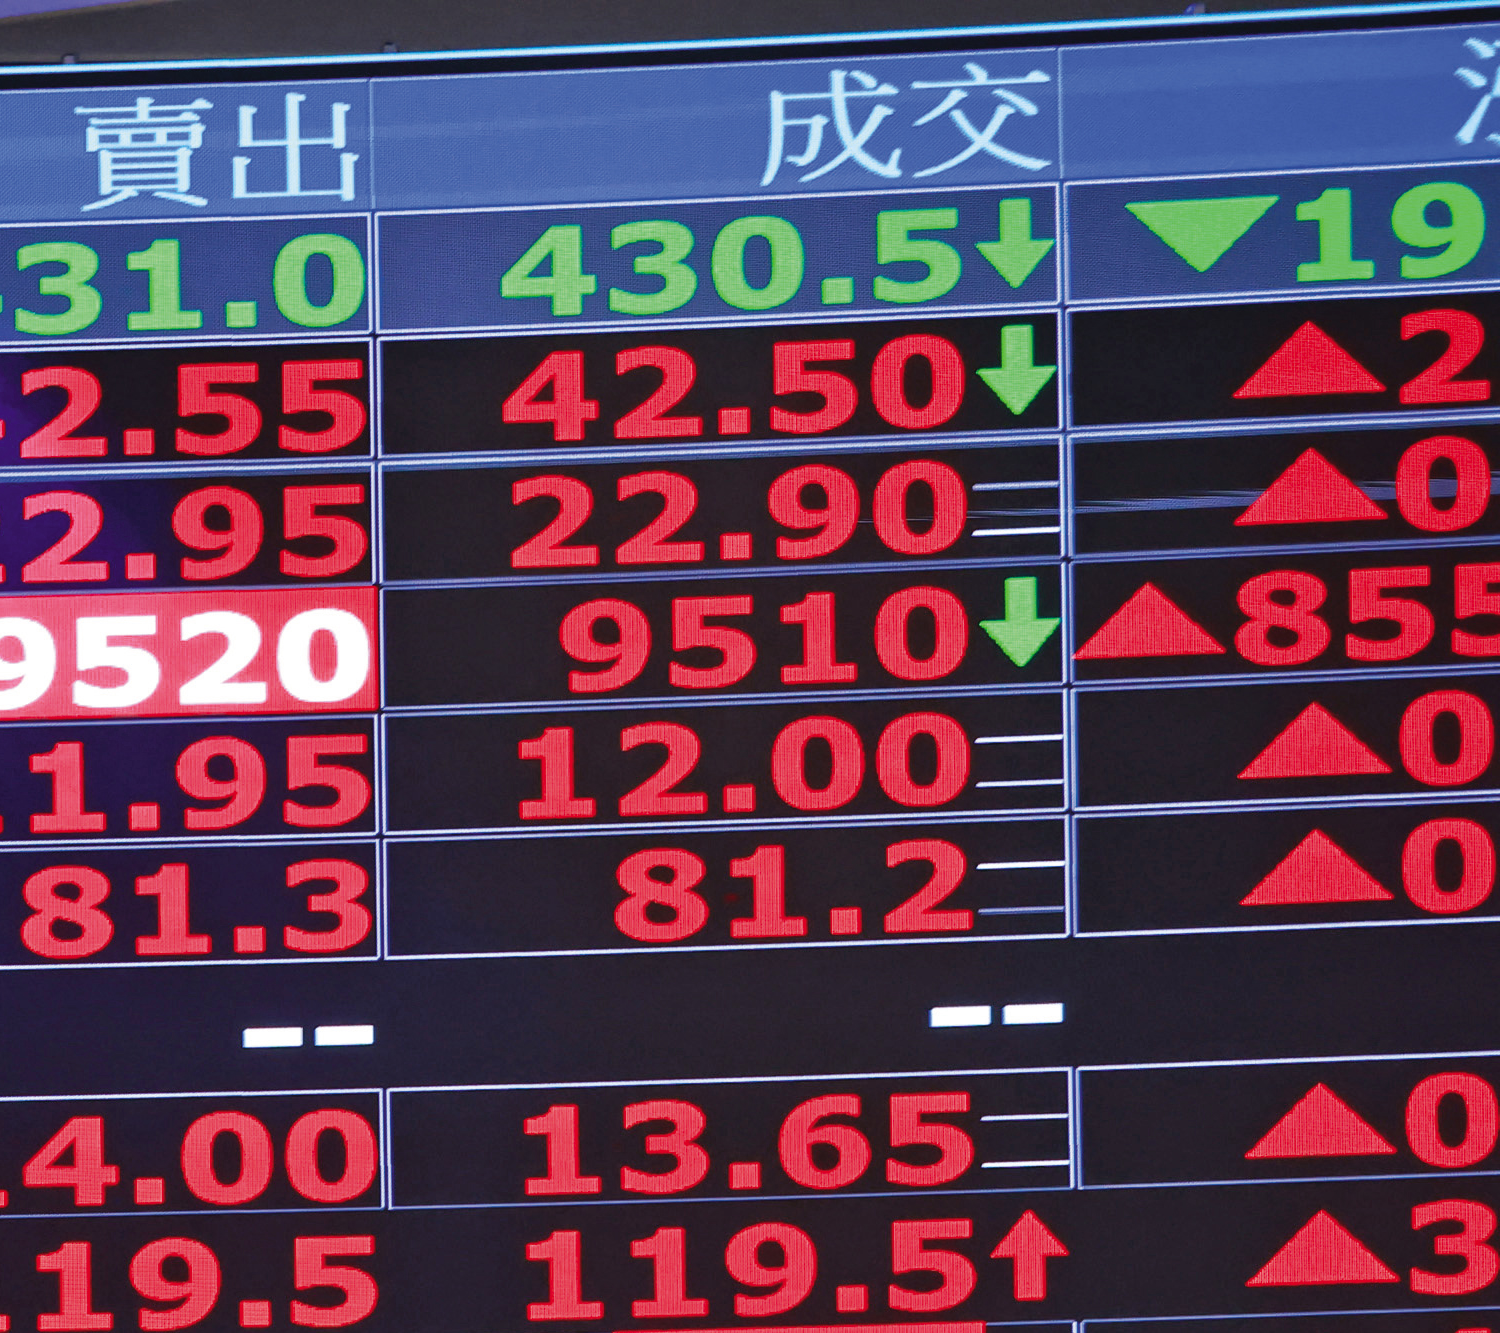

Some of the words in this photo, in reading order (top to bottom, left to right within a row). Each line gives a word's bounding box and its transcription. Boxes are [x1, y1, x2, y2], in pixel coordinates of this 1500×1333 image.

[76, 94, 366, 216] 賣出
[763, 65, 1055, 190] 成交
[500, 207, 962, 316] 430.5
[560, 586, 968, 693] 9510
[21, 859, 372, 959] 81.3
[614, 839, 973, 942] 81.2
[526, 1218, 980, 1323] 119.5
